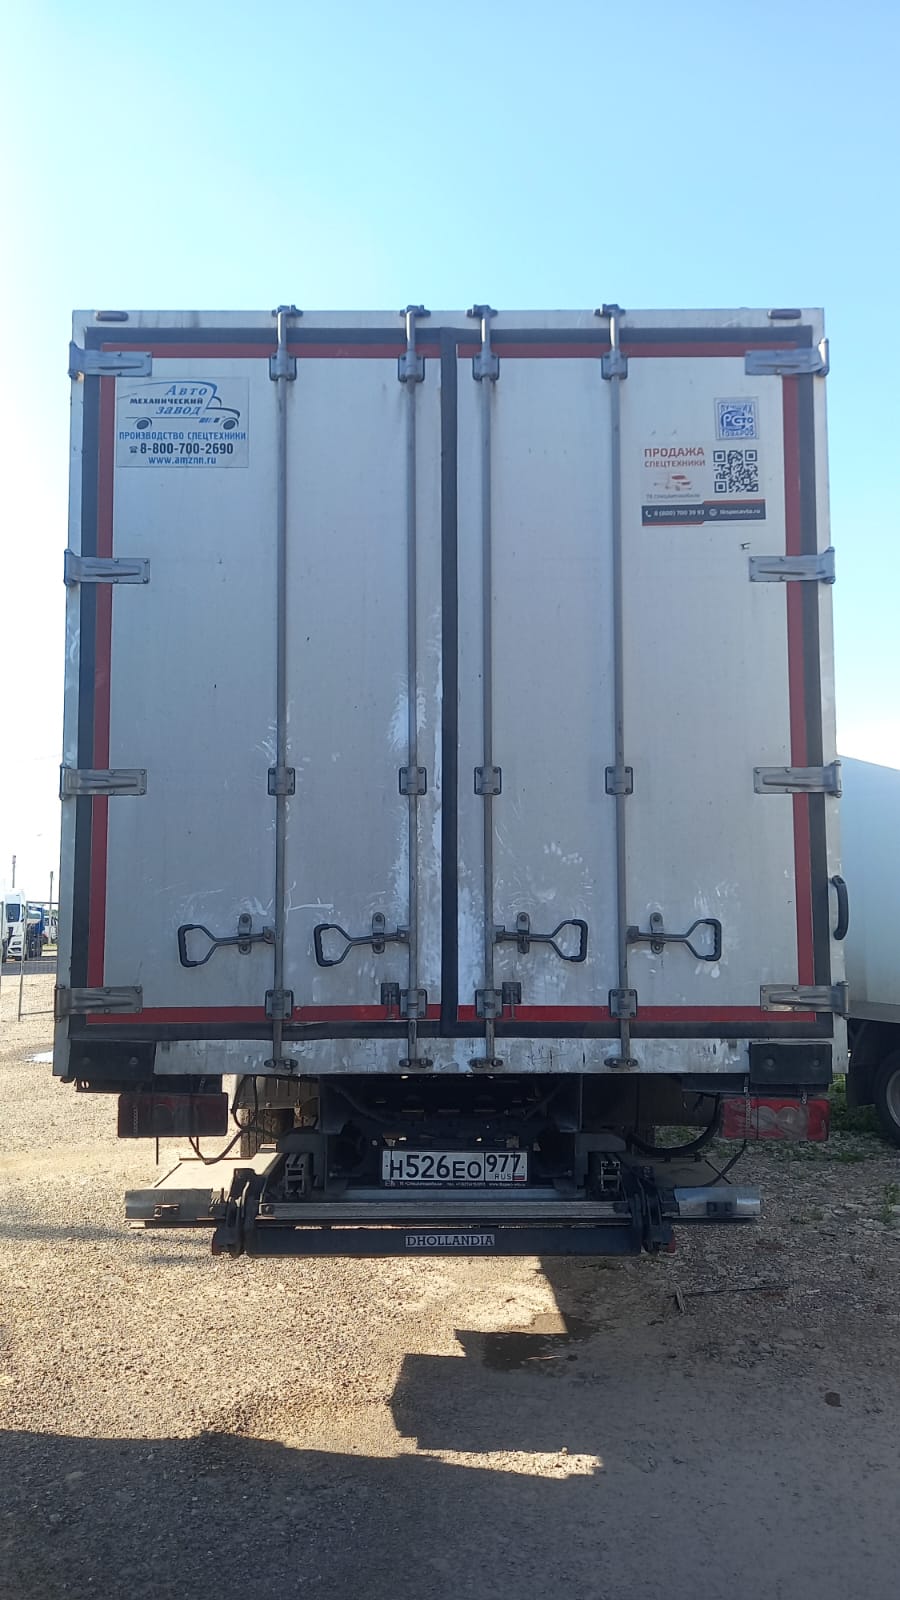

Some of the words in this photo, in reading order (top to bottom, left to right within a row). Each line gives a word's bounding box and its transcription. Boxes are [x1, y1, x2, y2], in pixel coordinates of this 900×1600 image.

[119, 432, 184, 440] ПРОИЗВОДСТВО
[187, 432, 246, 440] СПЕЦТЕХНИКИ
[140, 443, 234, 454] 8-800-700-2690
[644, 447, 705, 458] ПРОДАЖА
[644, 459, 706, 468] СПЕЦТЕХНИКИ
[390, 1154, 482, 1179] Н526ЕО
[486, 1154, 522, 1173] 977
[494, 1173, 512, 1181] RUS
[406, 1235, 493, 1247] DHOLLANDIA
